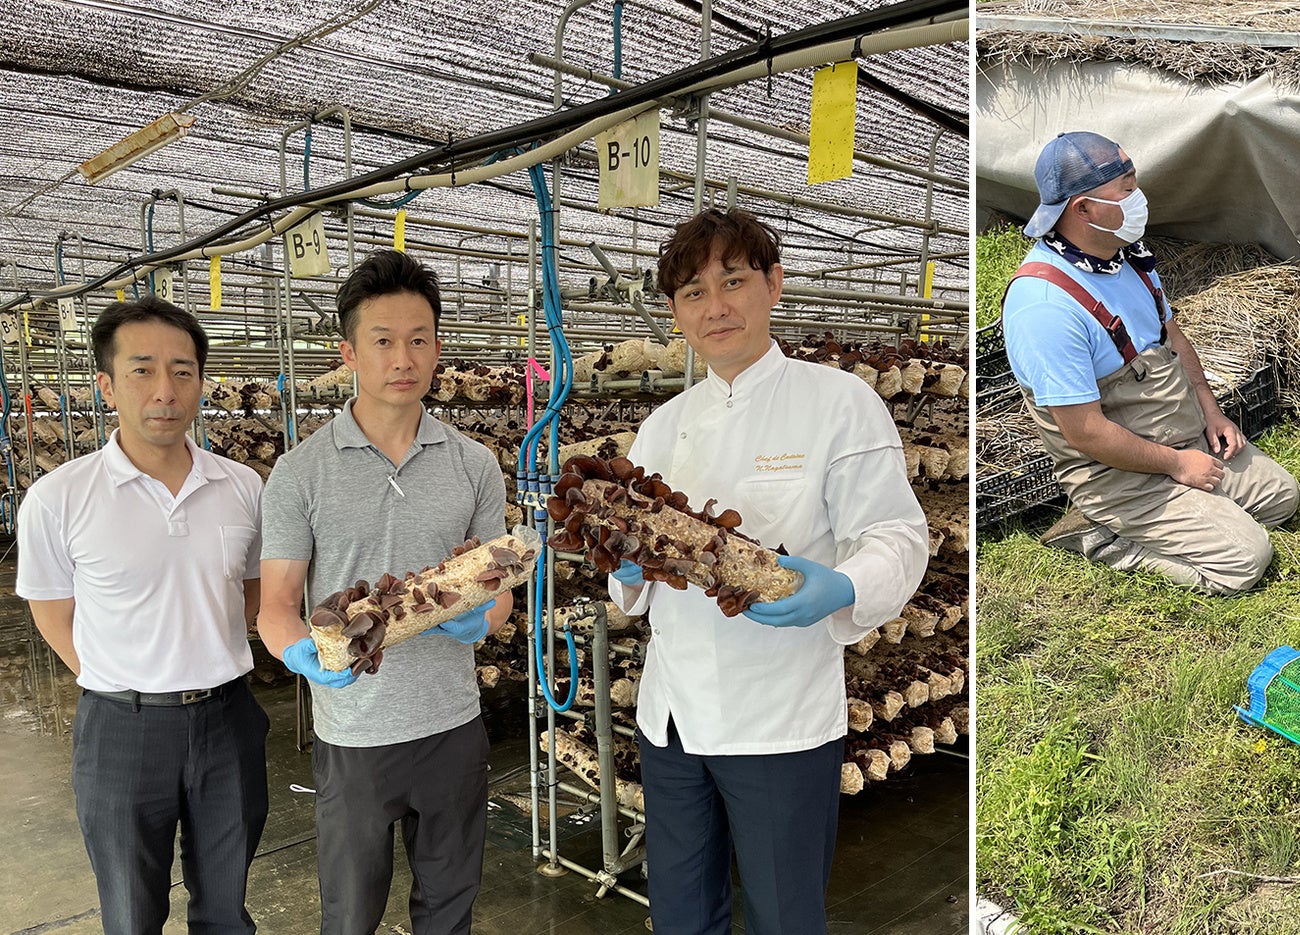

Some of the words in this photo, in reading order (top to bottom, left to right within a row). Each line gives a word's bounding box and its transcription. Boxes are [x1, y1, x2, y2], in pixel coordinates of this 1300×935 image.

[607, 135, 651, 172] B-10
[292, 229, 321, 259] B-9
[156, 278, 168, 298] -8
